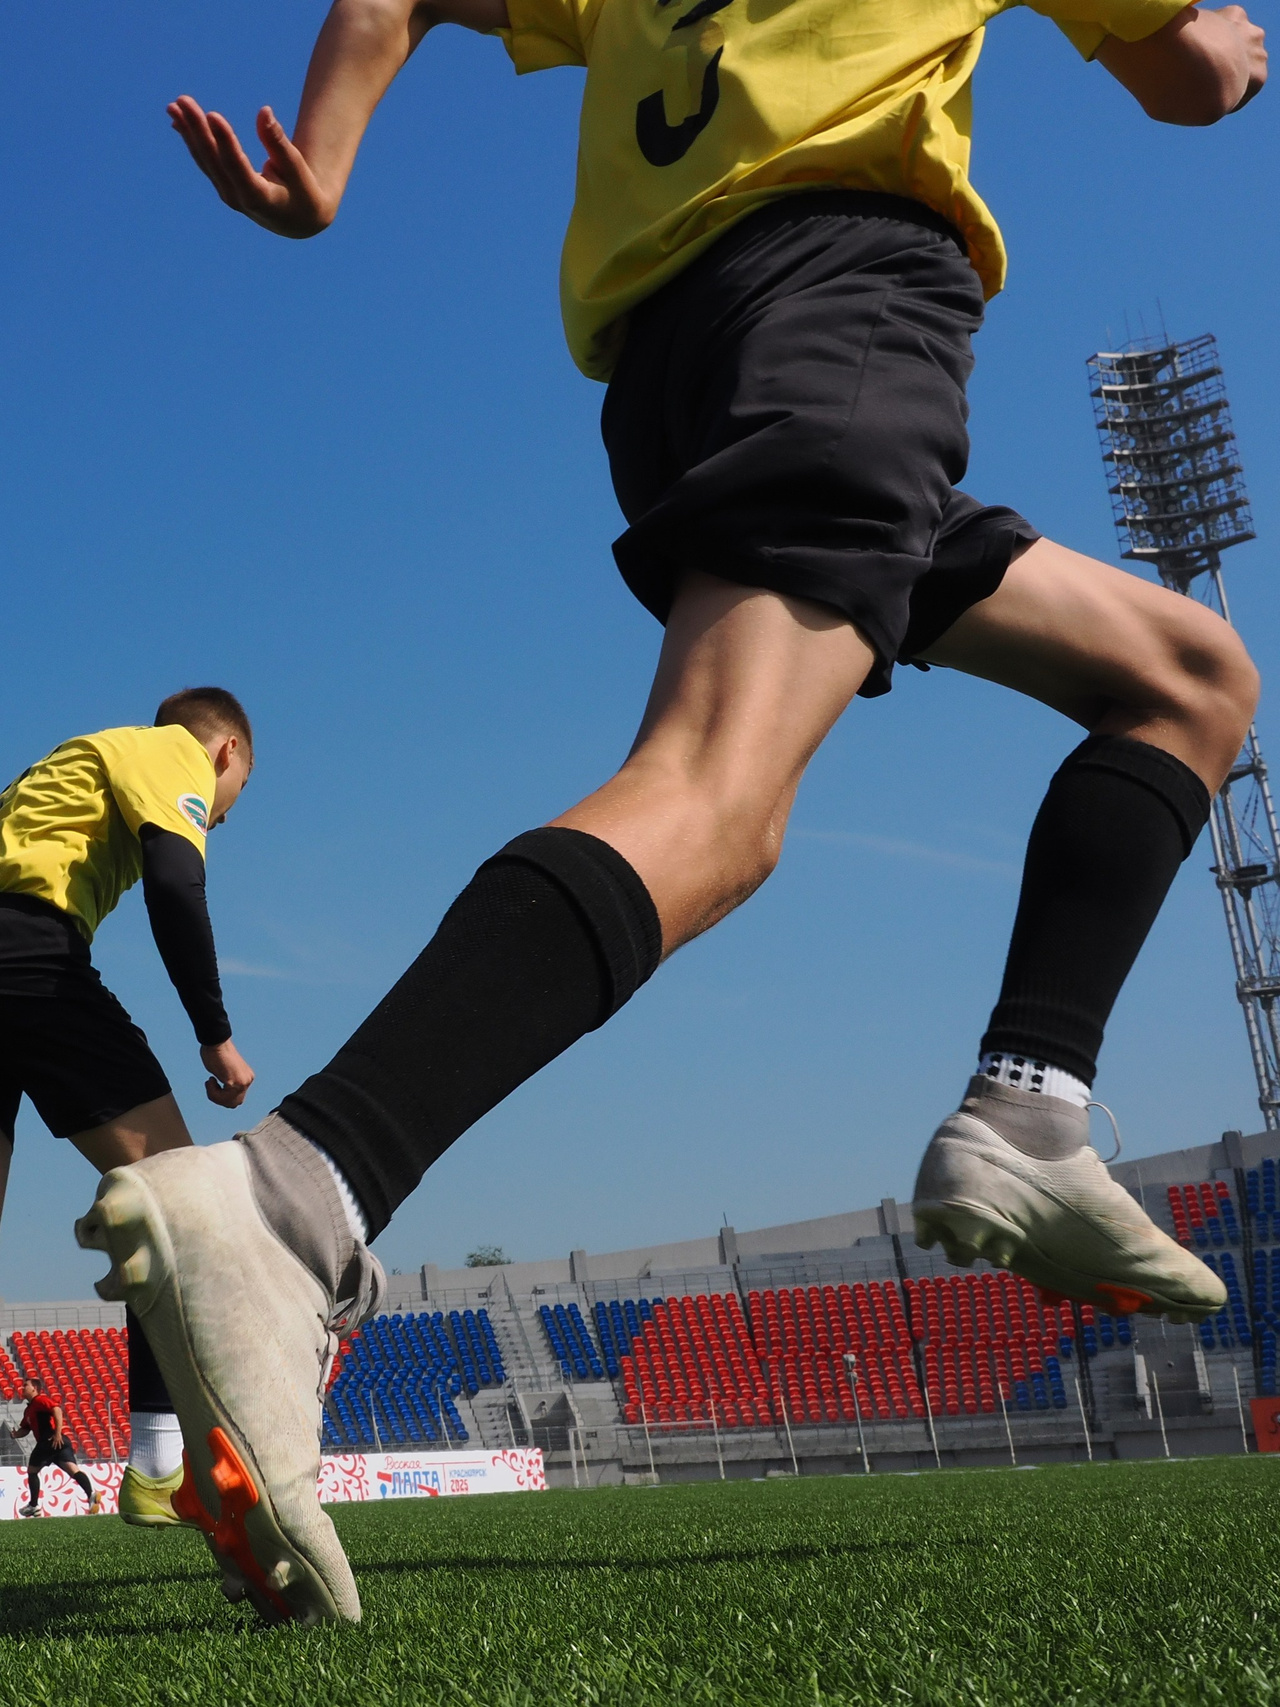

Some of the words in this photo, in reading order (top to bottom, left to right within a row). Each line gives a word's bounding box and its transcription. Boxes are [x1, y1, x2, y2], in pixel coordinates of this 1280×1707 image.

[384, 1455, 422, 1470] Русская
[449, 1468, 487, 1478] КРАСНОЯРСК
[392, 1471, 441, 1495] ЛАПТА
[450, 1479, 469, 1492] 2025
